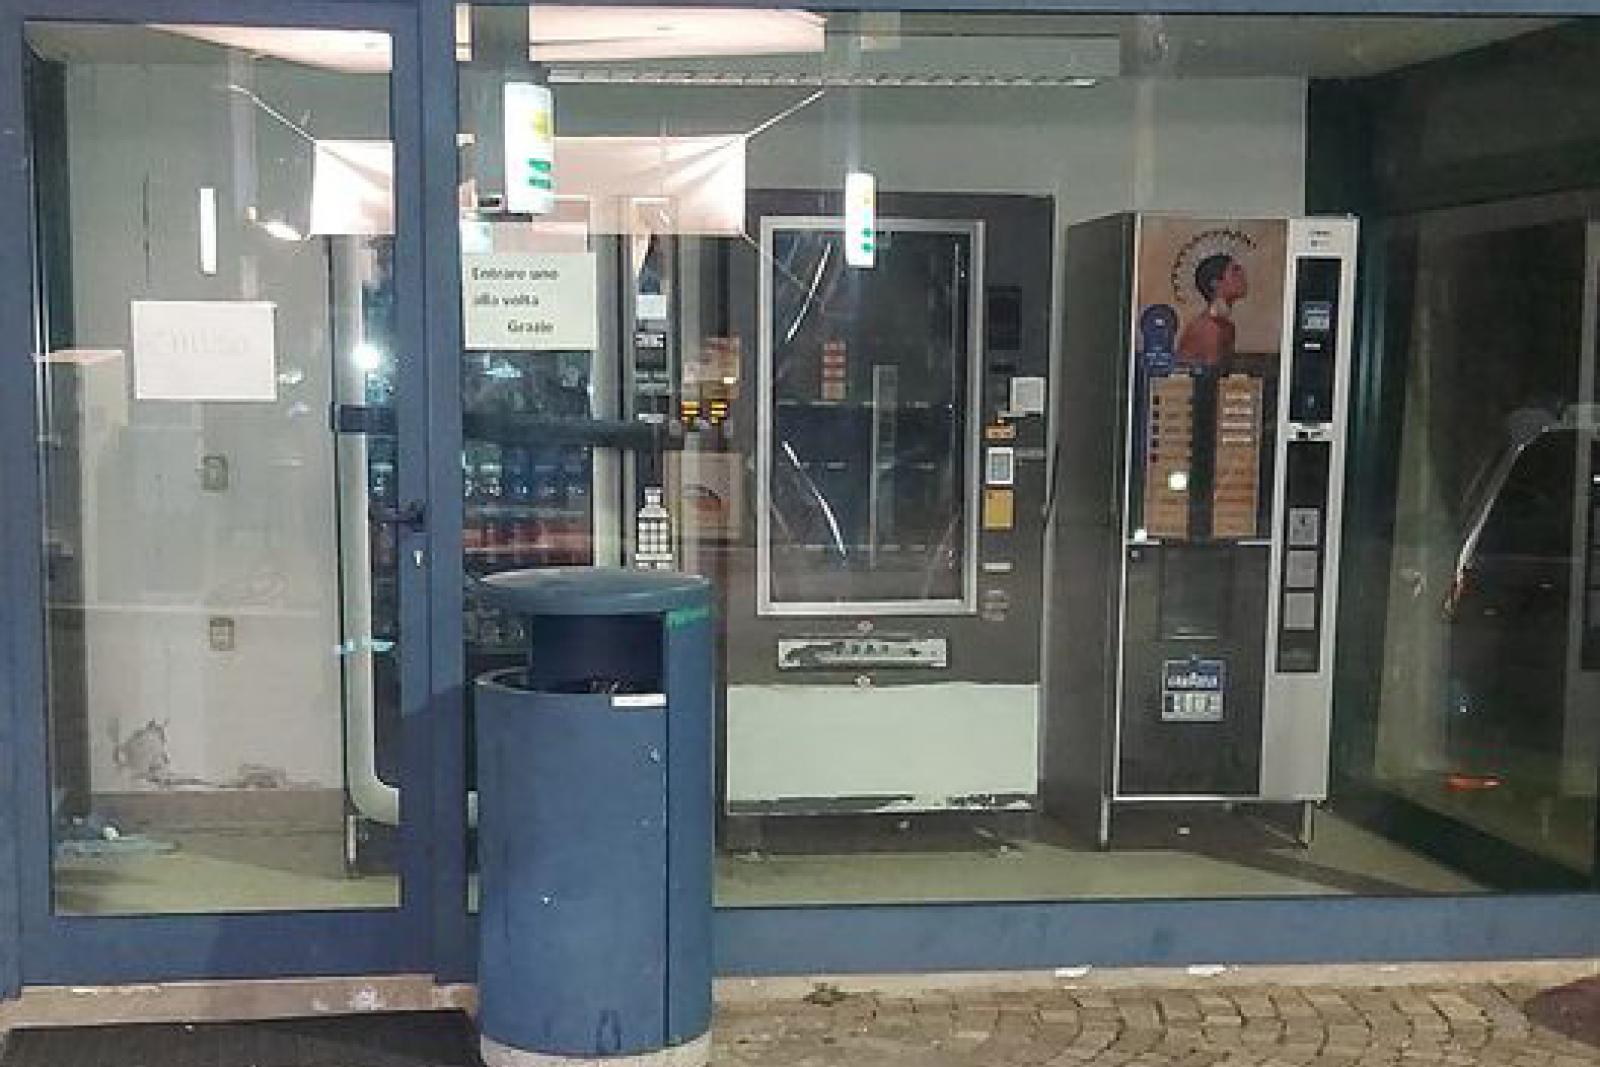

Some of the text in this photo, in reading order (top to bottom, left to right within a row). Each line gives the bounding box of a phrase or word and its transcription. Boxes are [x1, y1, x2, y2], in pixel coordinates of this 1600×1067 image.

[471, 267, 526, 281] Entrare
[474, 291, 539, 305] alla volta
